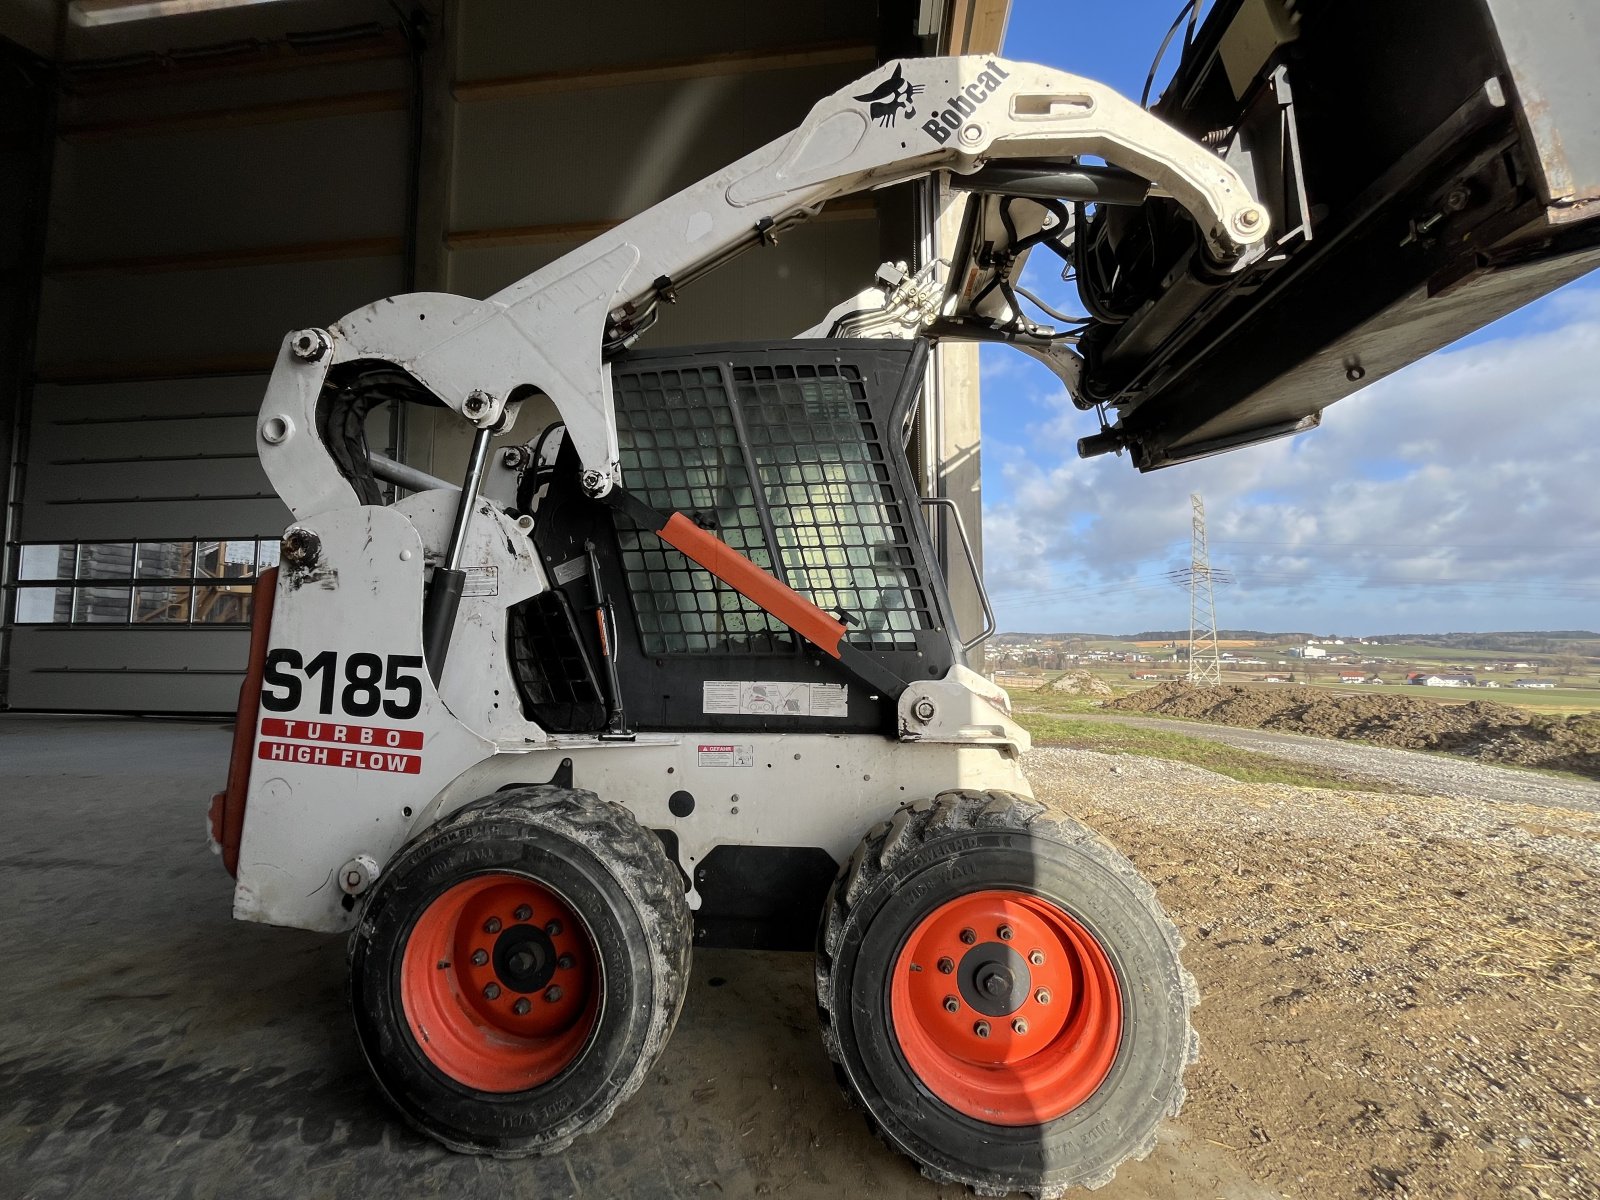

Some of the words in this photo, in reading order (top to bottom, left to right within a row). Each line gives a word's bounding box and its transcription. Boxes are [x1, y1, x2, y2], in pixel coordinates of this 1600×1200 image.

[921, 59, 1010, 145] Bobcat
[261, 648, 423, 720] S185
[271, 744, 328, 764] HIGH
[341, 751, 408, 772] FLOW
[284, 721, 400, 747] TURBO
